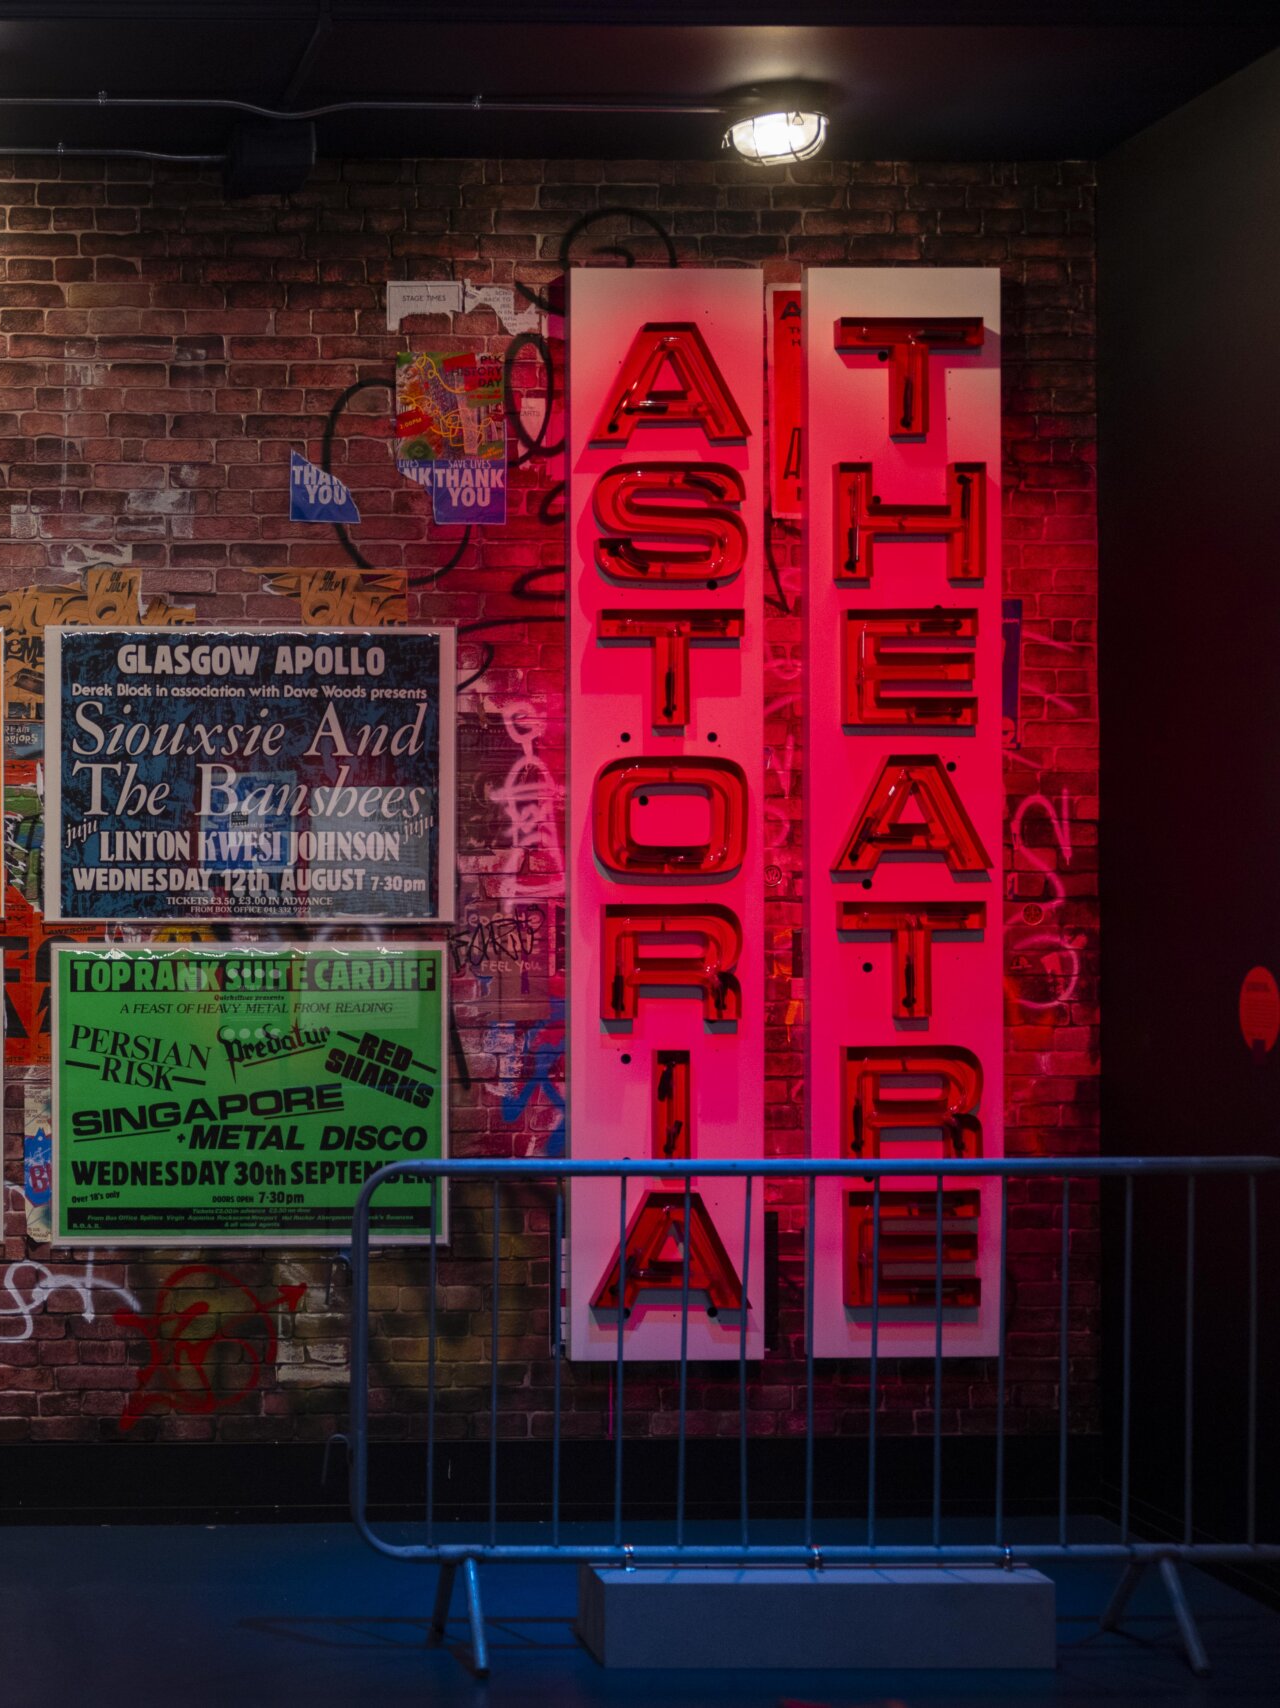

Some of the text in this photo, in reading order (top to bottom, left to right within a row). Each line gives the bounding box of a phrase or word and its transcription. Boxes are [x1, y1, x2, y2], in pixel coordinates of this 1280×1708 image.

[478, 378, 502, 388] DAY
[435, 468, 505, 488] THANK
[448, 459, 492, 469] SAVE LIVES
[305, 485, 347, 505] YOU
[448, 487, 491, 507] YOU
[117, 644, 386, 676] GLASGOW APOLLO
[72, 683, 428, 701] Derek Block in association with Dave Woods presents
[72, 700, 429, 757] Siouxsie And
[71, 762, 426, 819] The Banshees
[587, 321, 753, 1310] ASTORIA
[830, 317, 994, 1308] THEATRE
[65, 817, 99, 849] juju
[99, 830, 400, 866] LINTON KWESI JOHNSON
[72, 868, 213, 892] WEDNESDAY
[220, 868, 270, 892] 12th
[280, 868, 367, 892] AUGUST
[166, 896, 209, 906] TICKETS
[268, 896, 280, 906] IN
[282, 896, 334, 906] ADVANCE
[190, 906, 214, 914] FROM
[215, 906, 233, 914] BOX
[233, 906, 263, 914] OFFICE
[133, 961, 221, 992] RANK
[225, 961, 308, 991] SUITE
[314, 960, 433, 990] CARDIFF
[120, 1003, 393, 1014] A FEAST OF HEAVY METAL FROM READING
[68, 1023, 212, 1071] PERSIAN
[357, 1031, 414, 1072] RED
[100, 1056, 173, 1092] RISK
[324, 1048, 435, 1109] SHARKS
[71, 1082, 345, 1136] SINGAPORE
[188, 1124, 428, 1151] METAL DISCO
[71, 1160, 231, 1186] WEDNESDAY
[233, 1160, 286, 1186] 30th
[71, 1195, 88, 1204] Over
[105, 1190, 120, 1200] only
